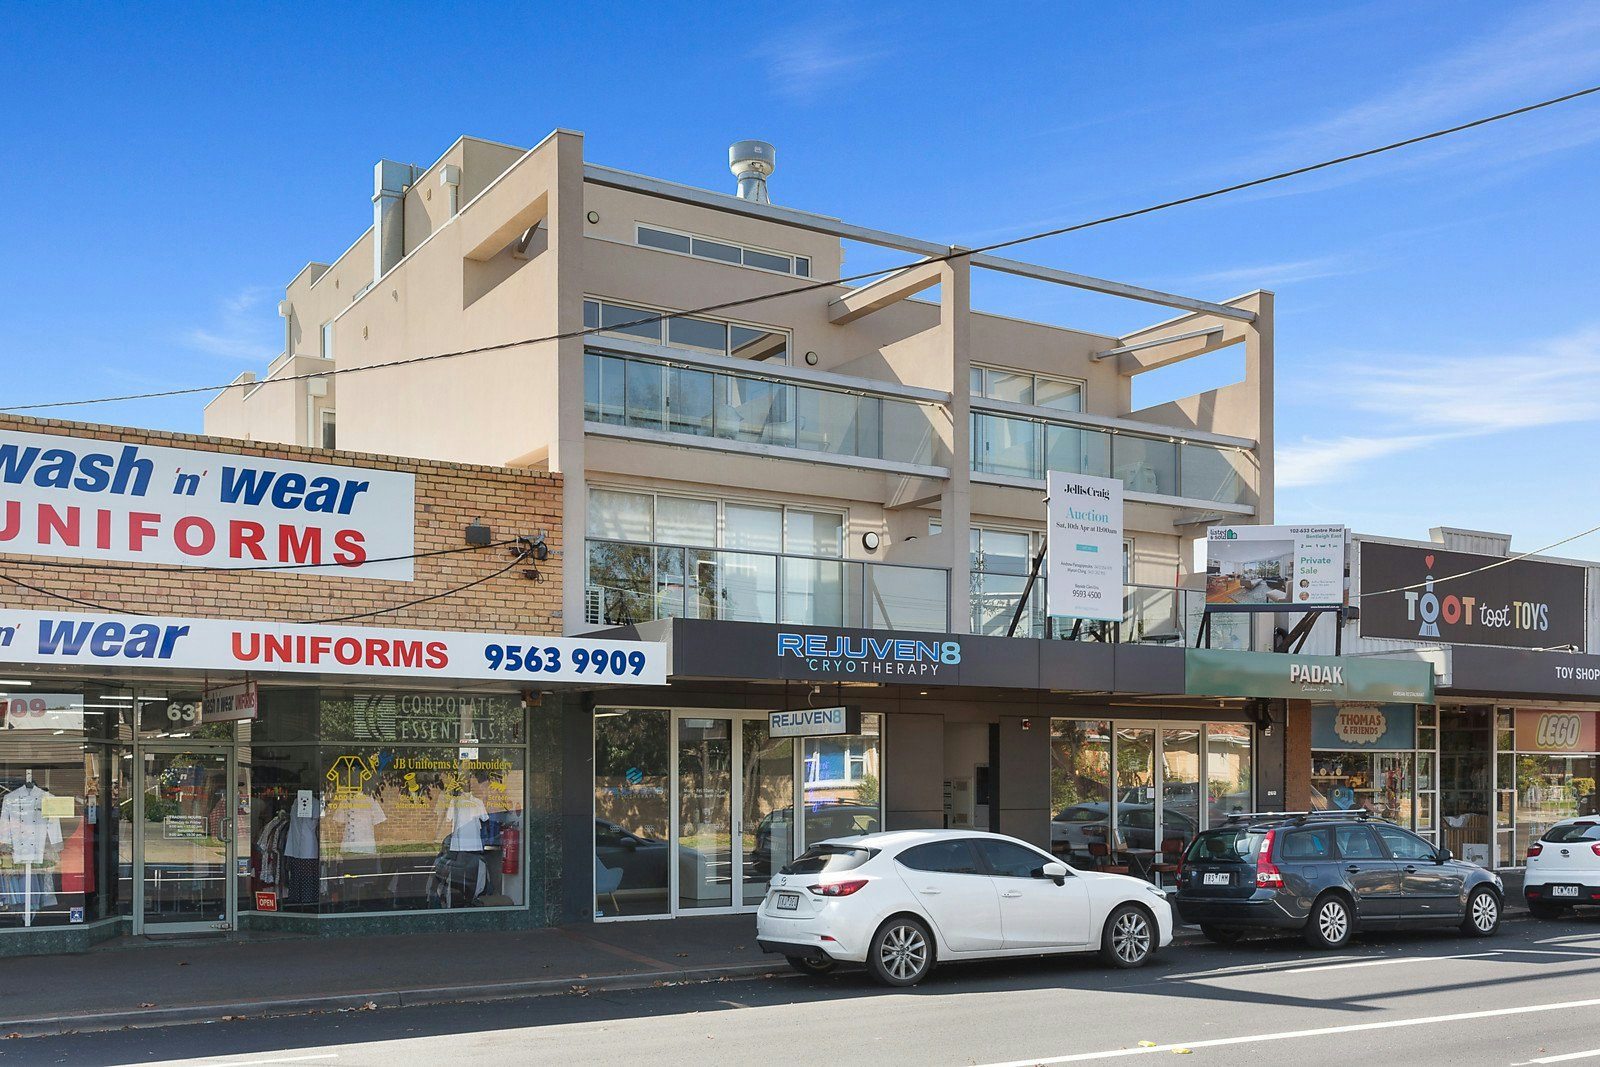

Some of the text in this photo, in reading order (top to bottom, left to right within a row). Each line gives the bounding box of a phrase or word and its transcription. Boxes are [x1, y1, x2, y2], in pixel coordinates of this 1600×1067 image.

[0, 444, 154, 497] wash
[220, 466, 369, 515] wear
[1066, 506, 1109, 523] Auction
[1080, 524, 1090, 533] Apr
[1072, 589, 1102, 599] 9593 4500
[1404, 591, 1549, 631] TOOT toot TOYS
[38, 619, 190, 659] wear
[232, 632, 449, 670] UNIFORMS
[485, 644, 561, 672] 9563
[572, 648, 646, 676] 9909
[778, 633, 961, 664] REJUVEN8
[1290, 664, 1344, 684] PADAK
[1555, 666, 1600, 680] TOY SHOP
[401, 695, 495, 715] CORPORATE
[772, 709, 842, 728] REJUVEN8
[1340, 714, 1381, 726] THOMAS
[402, 721, 495, 740] ESSENTIALS
[1343, 726, 1379, 735] & FRIENDS
[1537, 714, 1580, 747] LEGO
[393, 758, 513, 772] JB Uniforms & Embroidery
[260, 899, 274, 907] OPEN
